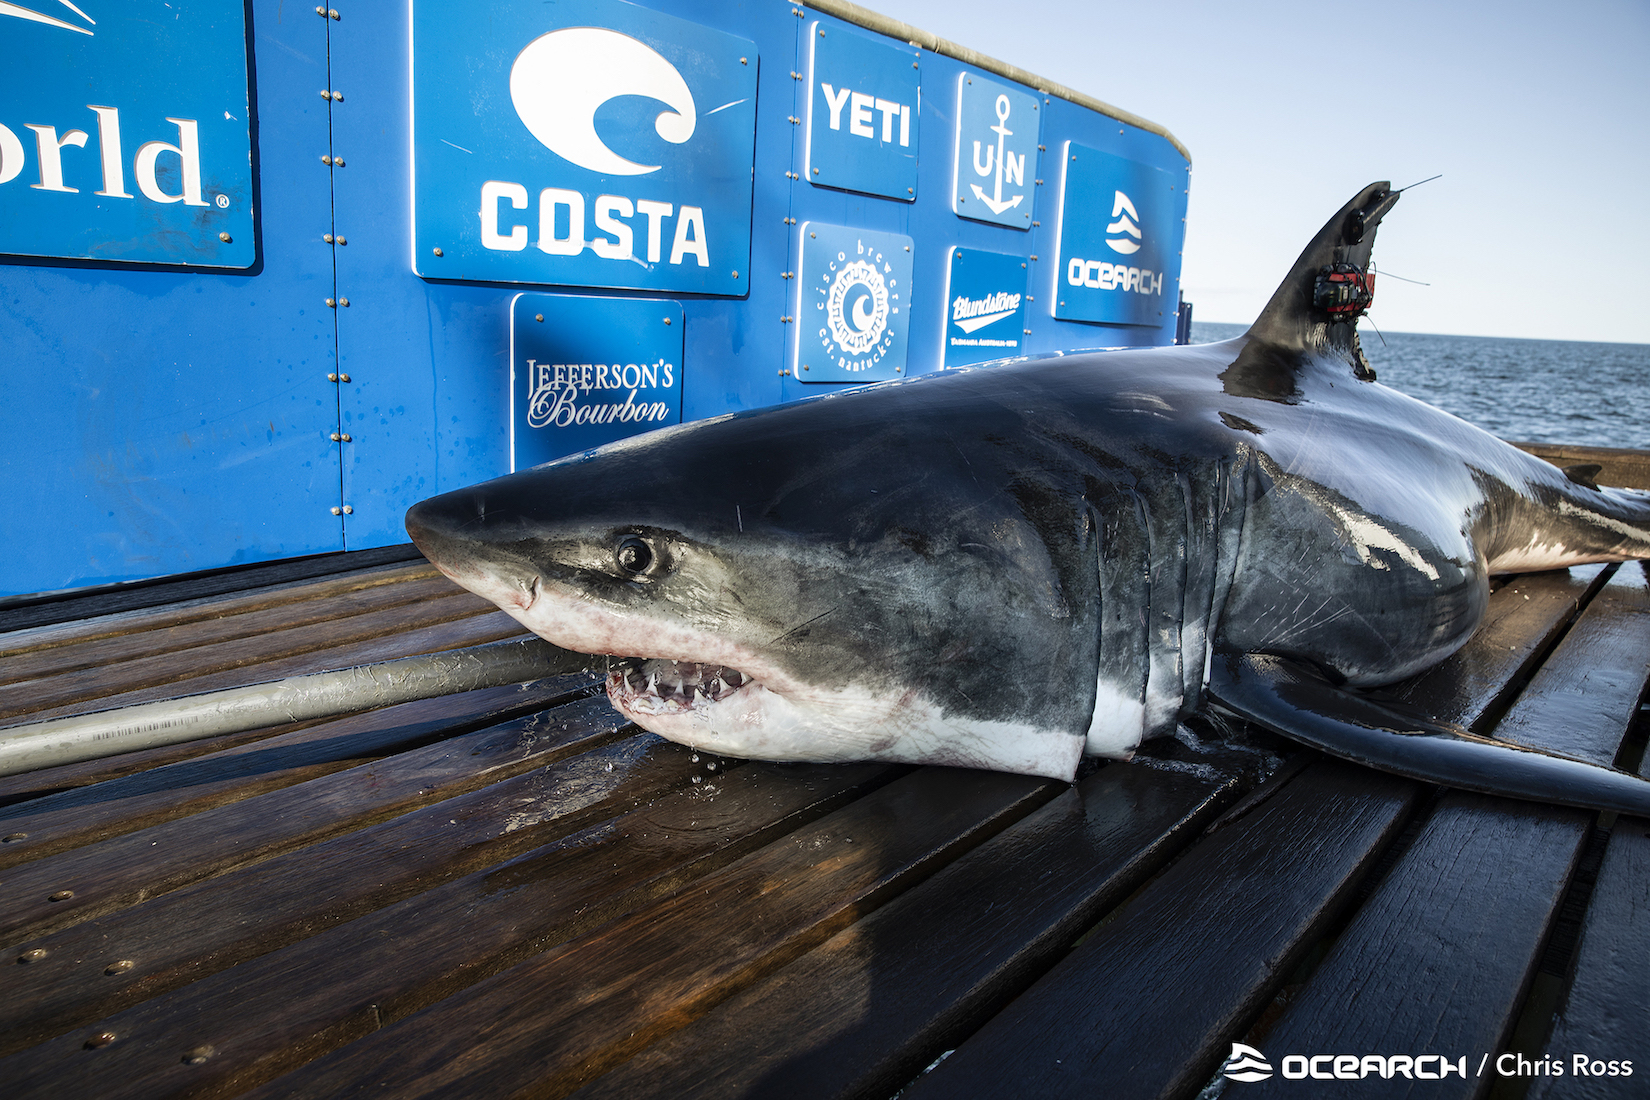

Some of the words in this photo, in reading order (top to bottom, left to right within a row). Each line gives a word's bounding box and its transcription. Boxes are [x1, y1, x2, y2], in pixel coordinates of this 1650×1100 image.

[821, 82, 911, 148] YETI
[479, 180, 710, 268] COSTA
[816, 251, 846, 311] cisco
[857, 239, 899, 314] brewers
[1067, 257, 1164, 297] OCEARCH
[953, 291, 1021, 321] Blundstone
[819, 328, 835, 360] est.
[838, 329, 895, 372] nantucket
[526, 358, 674, 400] JEFFERSON'S
[527, 380, 670, 429] Bourbon
